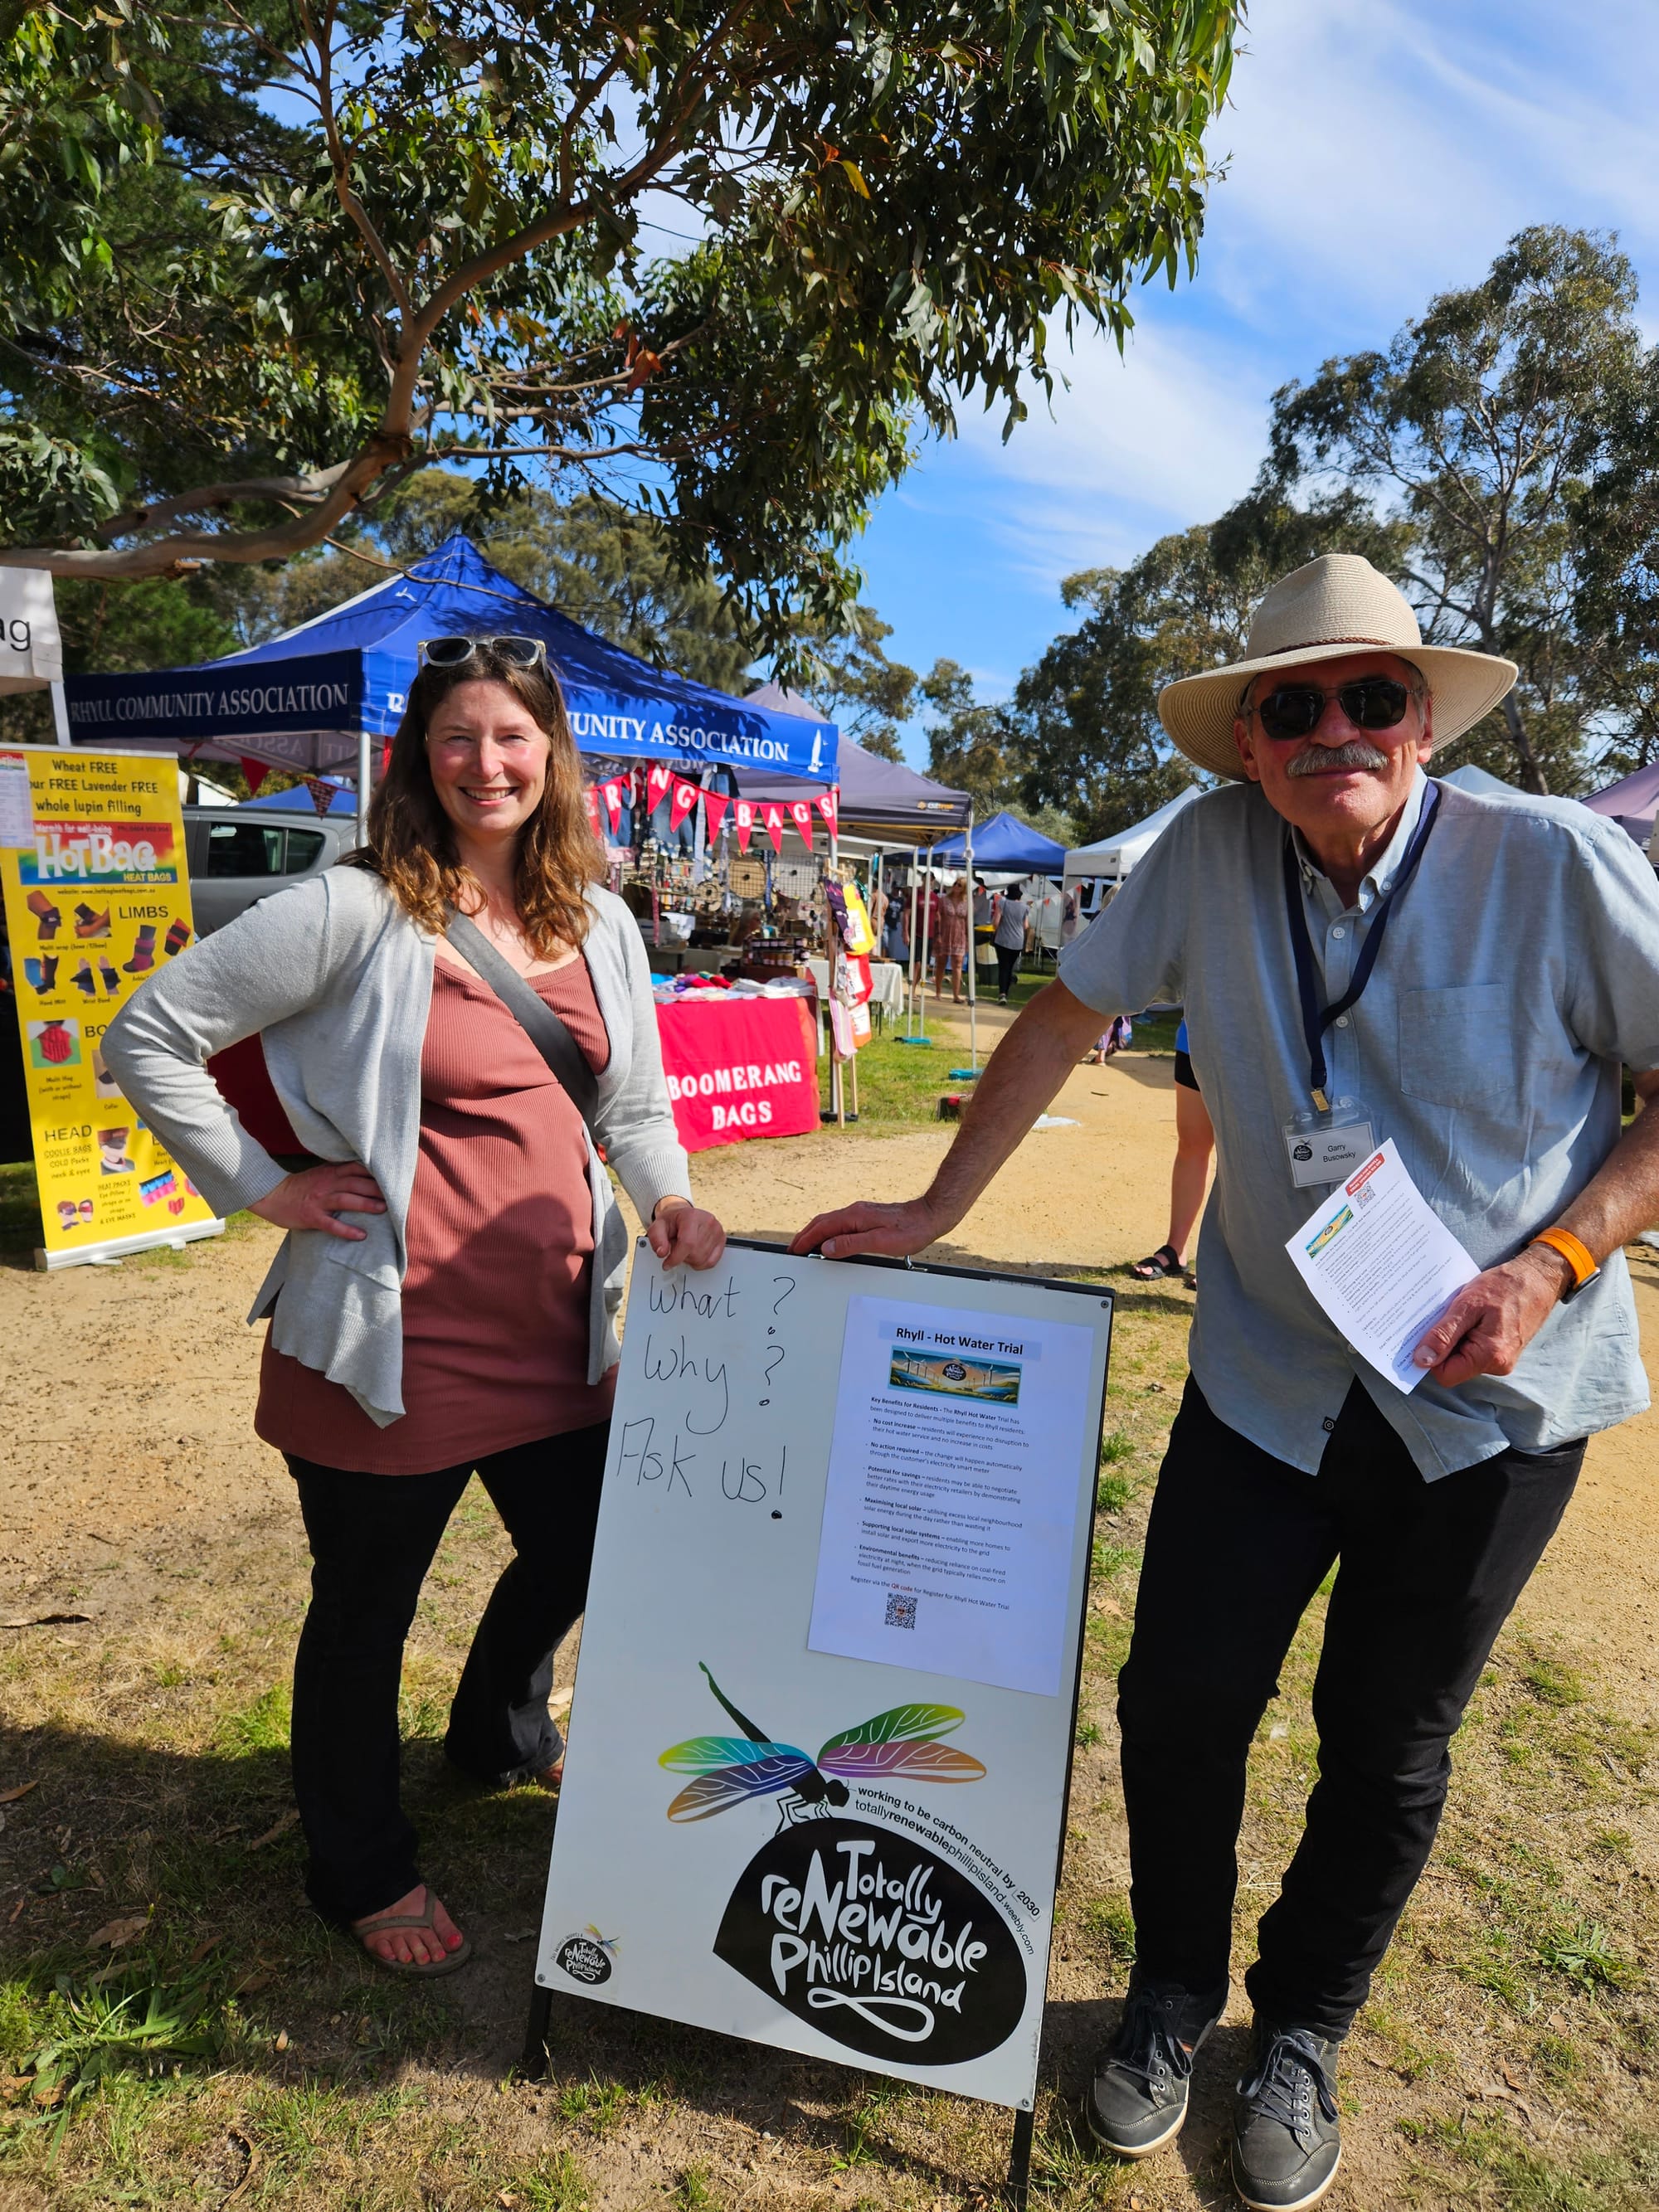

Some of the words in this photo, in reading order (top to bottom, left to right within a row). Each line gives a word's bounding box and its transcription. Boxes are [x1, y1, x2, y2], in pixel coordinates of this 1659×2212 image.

[71, 700, 113, 722] RHYLL
[115, 692, 215, 720] COMMUNITY
[218, 683, 349, 717] ASSOCIATION
[650, 722, 790, 761] ASSOCIATION
[51, 760, 86, 773] Wheat
[90, 761, 118, 775] FREE
[49, 778, 78, 791] FREE
[81, 780, 127, 792] Lavender
[131, 781, 159, 794] FREE
[36, 798, 70, 812] whole
[74, 798, 104, 815] lupin
[108, 800, 141, 816] filling
[738, 796, 834, 828] BAGS
[123, 873, 145, 882] HEAT
[148, 873, 171, 882] BAGS
[119, 906, 168, 919] LIMBS
[666, 1061, 801, 1101] BOOMERANG
[712, 1101, 771, 1130] BAGS
[45, 1125, 91, 1142] HEAD
[73, 1144, 92, 1155] BAGS
[1328, 1144, 1345, 1153] Garry
[50, 1159, 68, 1168] COLD
[1322, 1151, 1355, 1163] Busowsky
[649, 1274, 741, 1319] What
[767, 1276, 795, 1335] ?
[896, 1327, 924, 1342] Rhyll
[934, 1333, 956, 1345] Hot
[959, 1336, 995, 1350] Water
[998, 1342, 1024, 1355] Trial
[645, 1334, 728, 1435] Why
[758, 1345, 785, 1407] ?
[883, 1407, 907, 1416] designed
[912, 1403, 938, 1412] Residents
[994, 1437, 1022, 1446] disruption
[868, 1466, 891, 1474] Potential
[934, 1452, 952, 1461] change
[965, 1456, 985, 1465] happen
[985, 1461, 1022, 1472] automatically
[864, 1496, 893, 1508] Maximising
[862, 1520, 890, 1531] Supporting
[859, 1544, 897, 1556] Environmental
[898, 1552, 919, 1560] benefits
[850, 1575, 871, 1583] Register
[922, 1589, 943, 1597] Register
[979, 1599, 995, 1607] Water
[858, 1787, 902, 1808] working
[904, 1801, 914, 1812] to
[917, 1806, 931, 1821] be
[932, 1816, 969, 1845] carbon
[969, 1843, 1002, 1878] neutral
[1002, 1873, 1015, 1889] by
[1016, 1890, 1040, 1917] 2030
[836, 1840, 942, 1924] Totally
[855, 1798, 1035, 1956] totallyrenewablephillipisland.weebly.com
